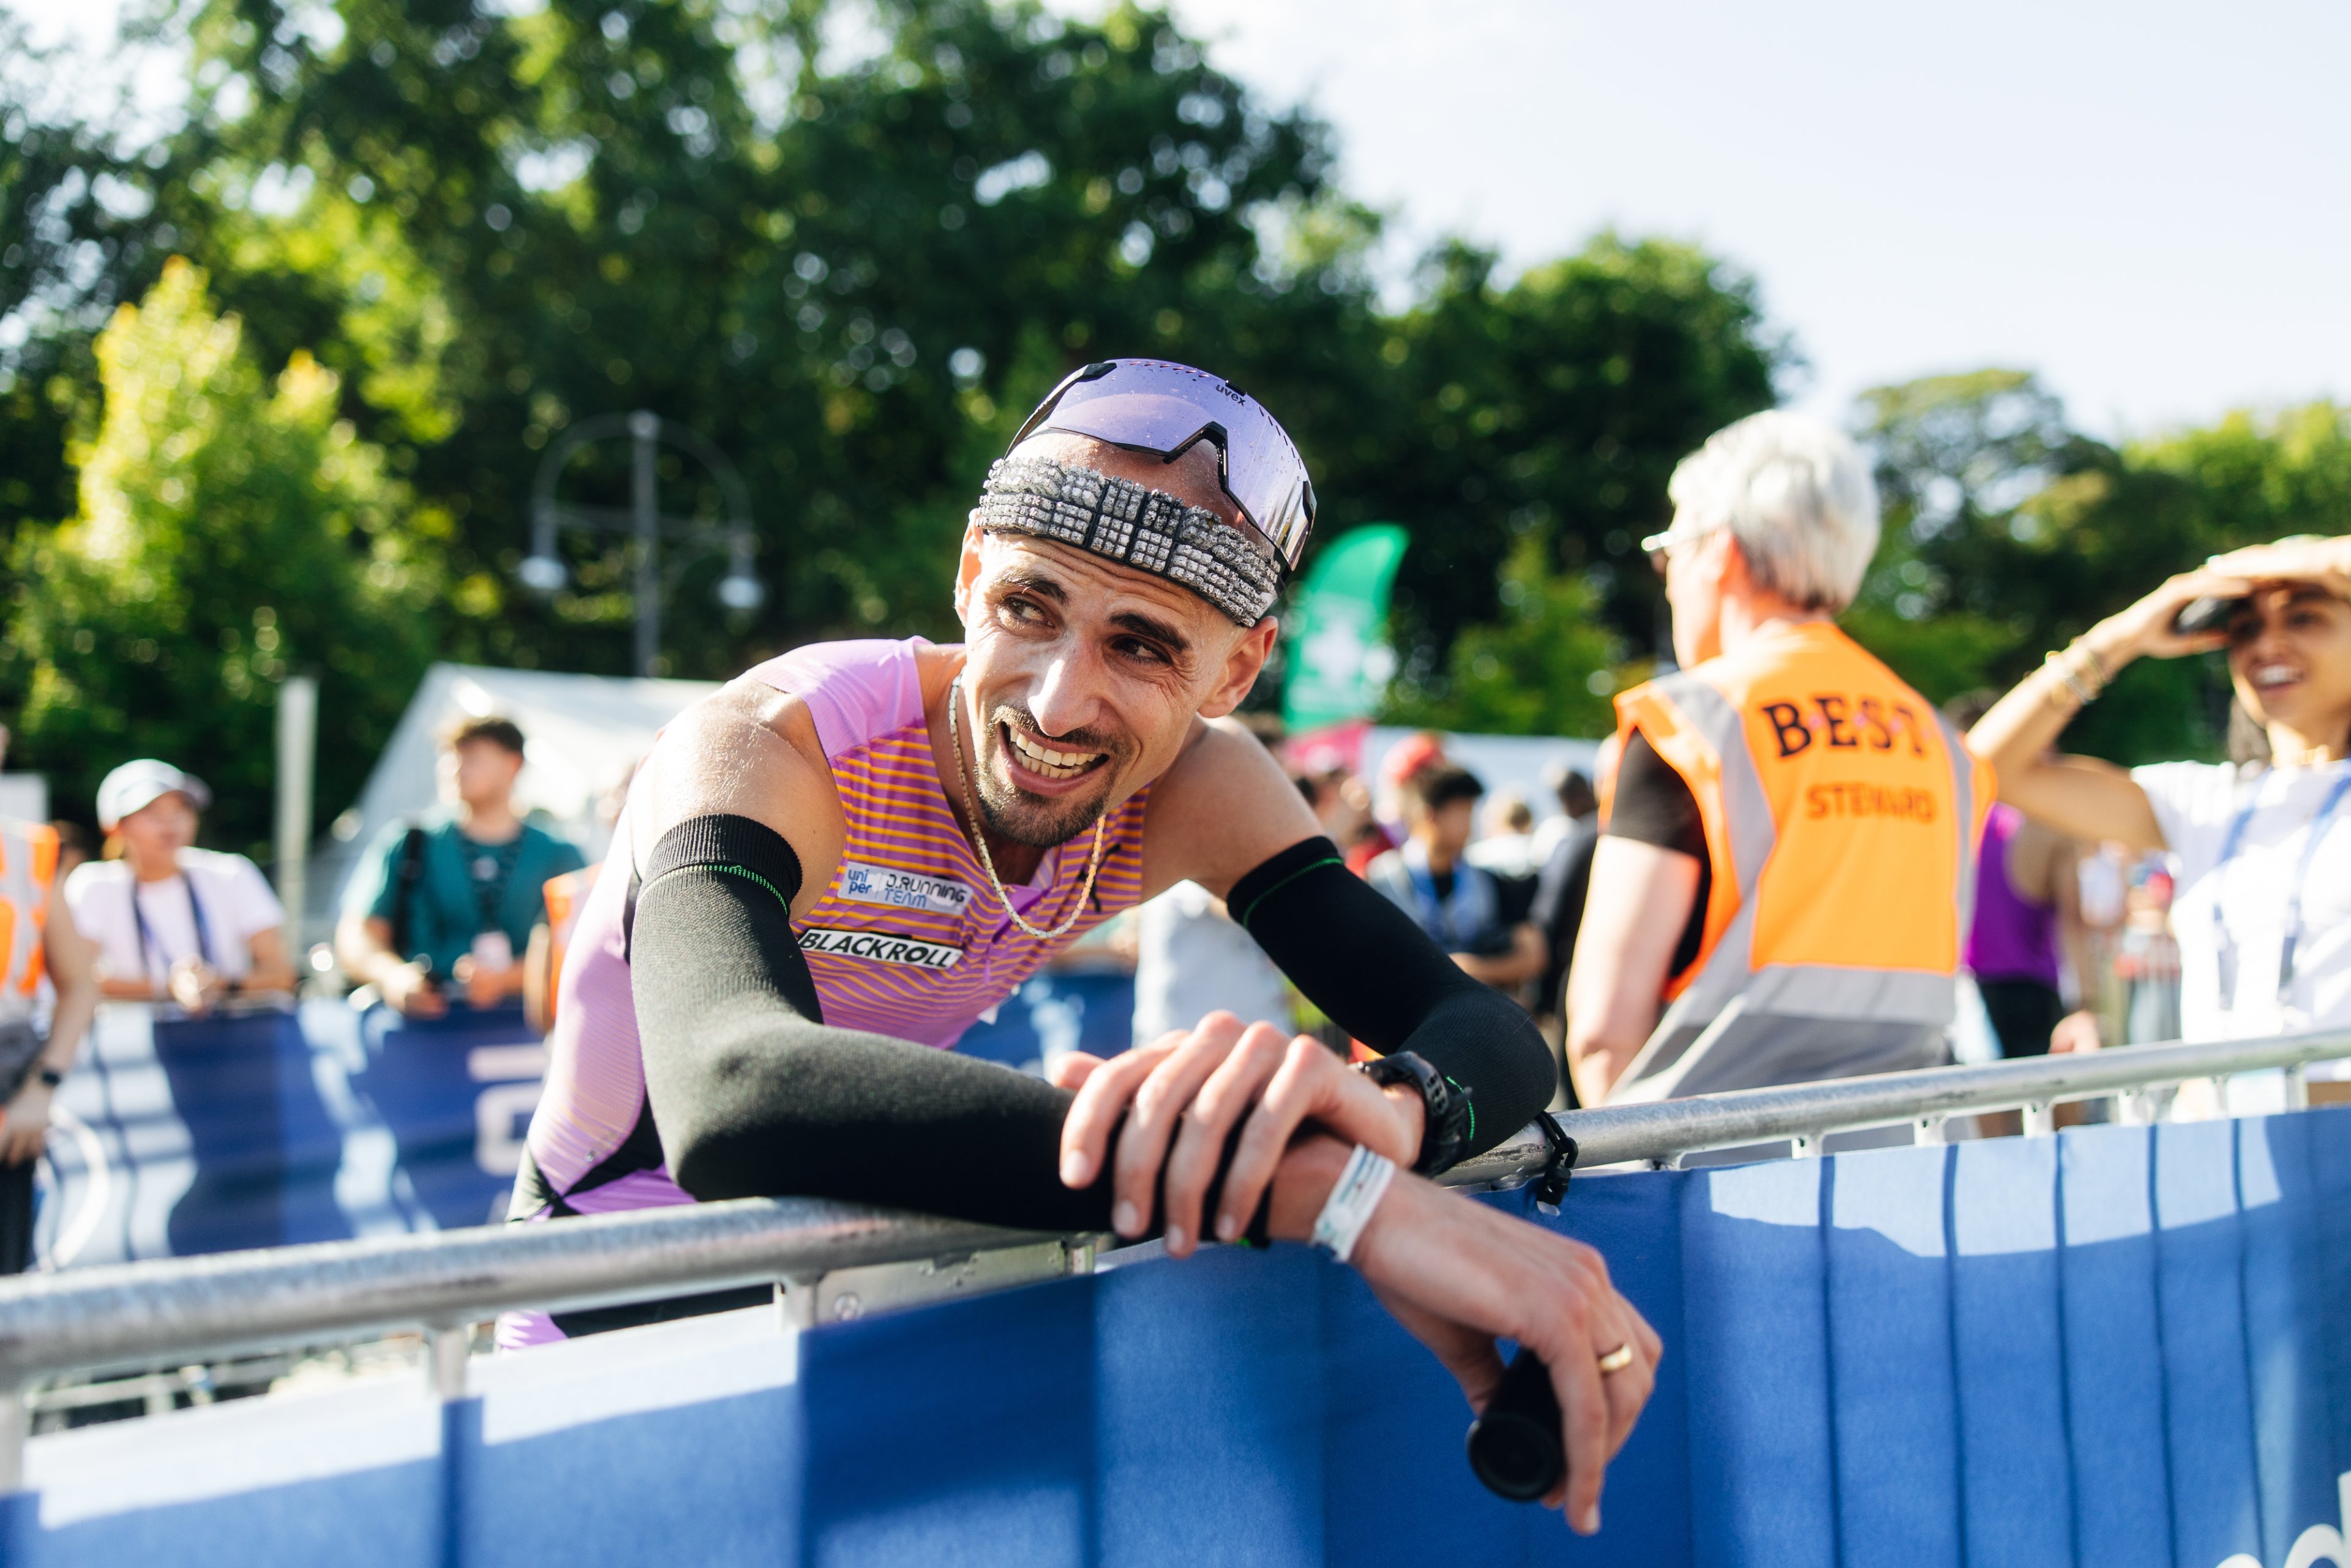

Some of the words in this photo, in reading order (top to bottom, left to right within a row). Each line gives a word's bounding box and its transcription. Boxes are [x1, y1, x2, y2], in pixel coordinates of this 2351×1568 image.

[1216, 384, 1246, 407] uvex
[1761, 697, 1924, 758] BEST
[848, 869, 869, 882] uni
[849, 882, 872, 894] per
[885, 888, 927, 908] TEAM
[799, 932, 953, 968] BLACKROLL
